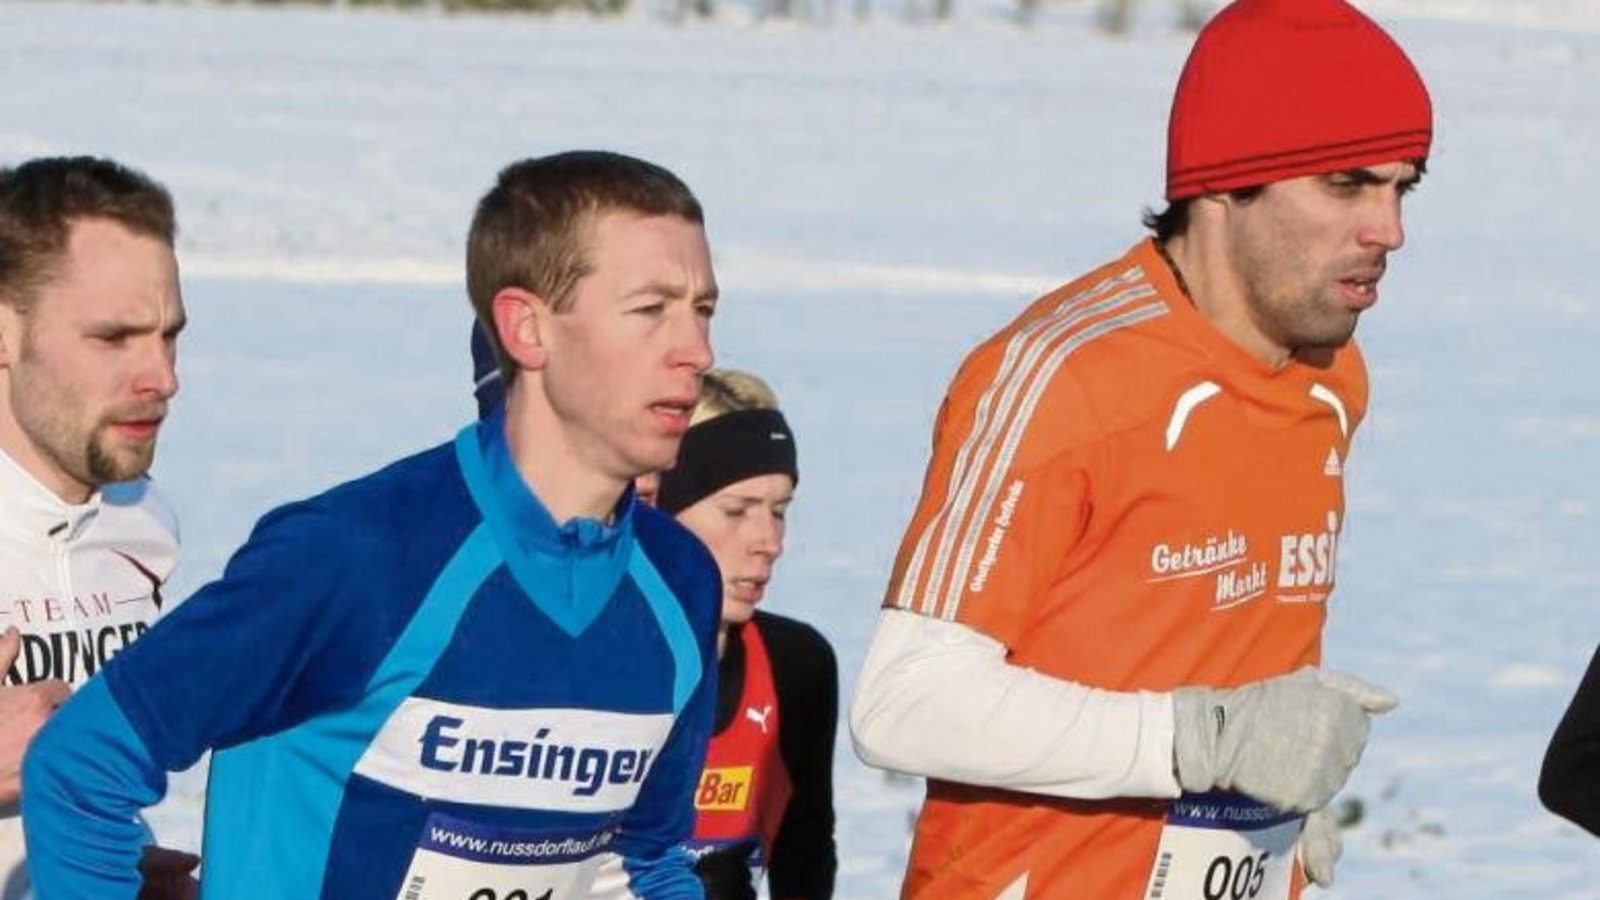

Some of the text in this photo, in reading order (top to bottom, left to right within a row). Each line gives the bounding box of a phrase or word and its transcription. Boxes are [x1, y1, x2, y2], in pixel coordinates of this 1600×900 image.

[1151, 528, 1248, 573] Getränke
[1214, 562, 1267, 604] Markt
[15, 592, 112, 623] TEAM
[419, 715, 651, 796] Ensinger
[1203, 851, 1271, 900] 005
